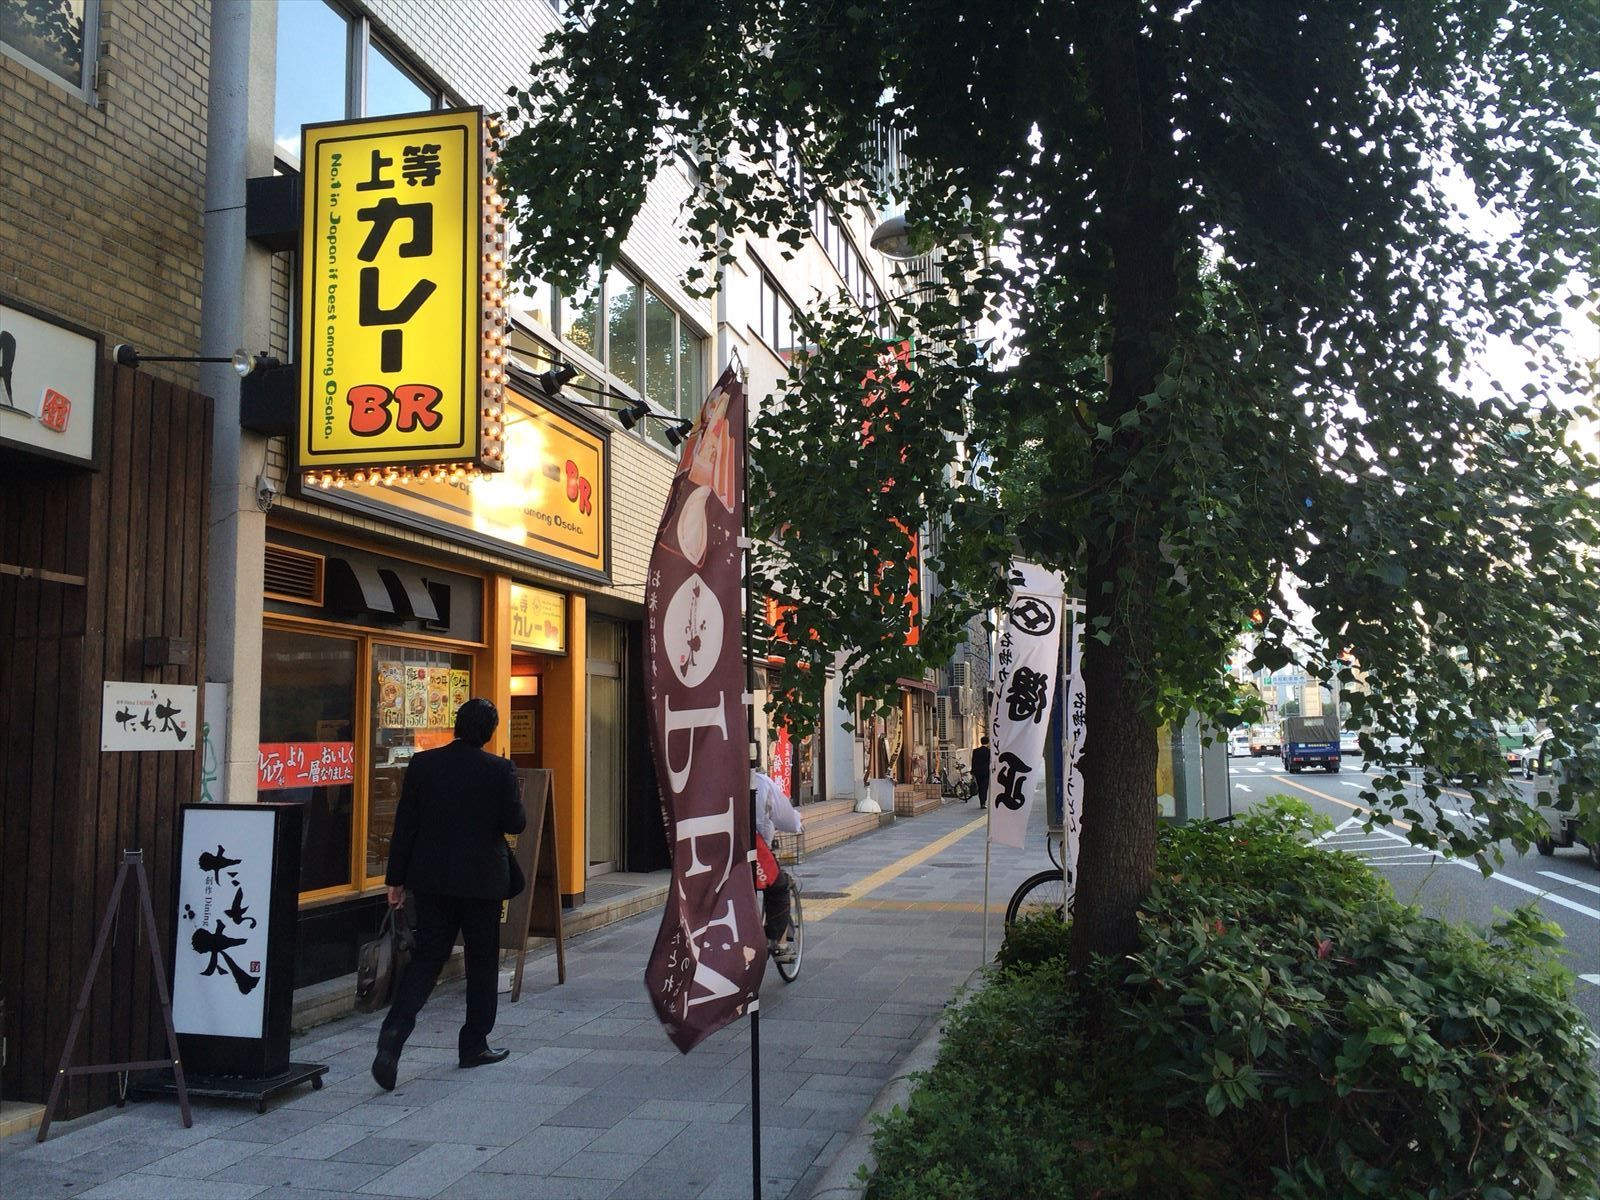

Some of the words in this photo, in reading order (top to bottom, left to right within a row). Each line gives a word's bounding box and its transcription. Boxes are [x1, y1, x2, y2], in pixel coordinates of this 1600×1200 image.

[330, 153, 343, 189] No.1
[356, 144, 441, 191] 上等
[330, 193, 341, 207] in
[326, 211, 341, 265] Japan
[328, 268, 339, 280] if
[356, 197, 437, 373] カレー
[327, 284, 338, 321] best
[323, 325, 335, 377] among
[324, 380, 337, 440] Osaka.
[346, 383, 443, 437] BR
[565, 459, 592, 517] BR
[554, 514, 584, 535] Osaka.
[513, 612, 543, 638] カレー
[287, 746, 304, 769] より
[296, 760, 321, 783] 一層
[321, 746, 354, 764] おいしく
[202, 897, 213, 927] Dining
